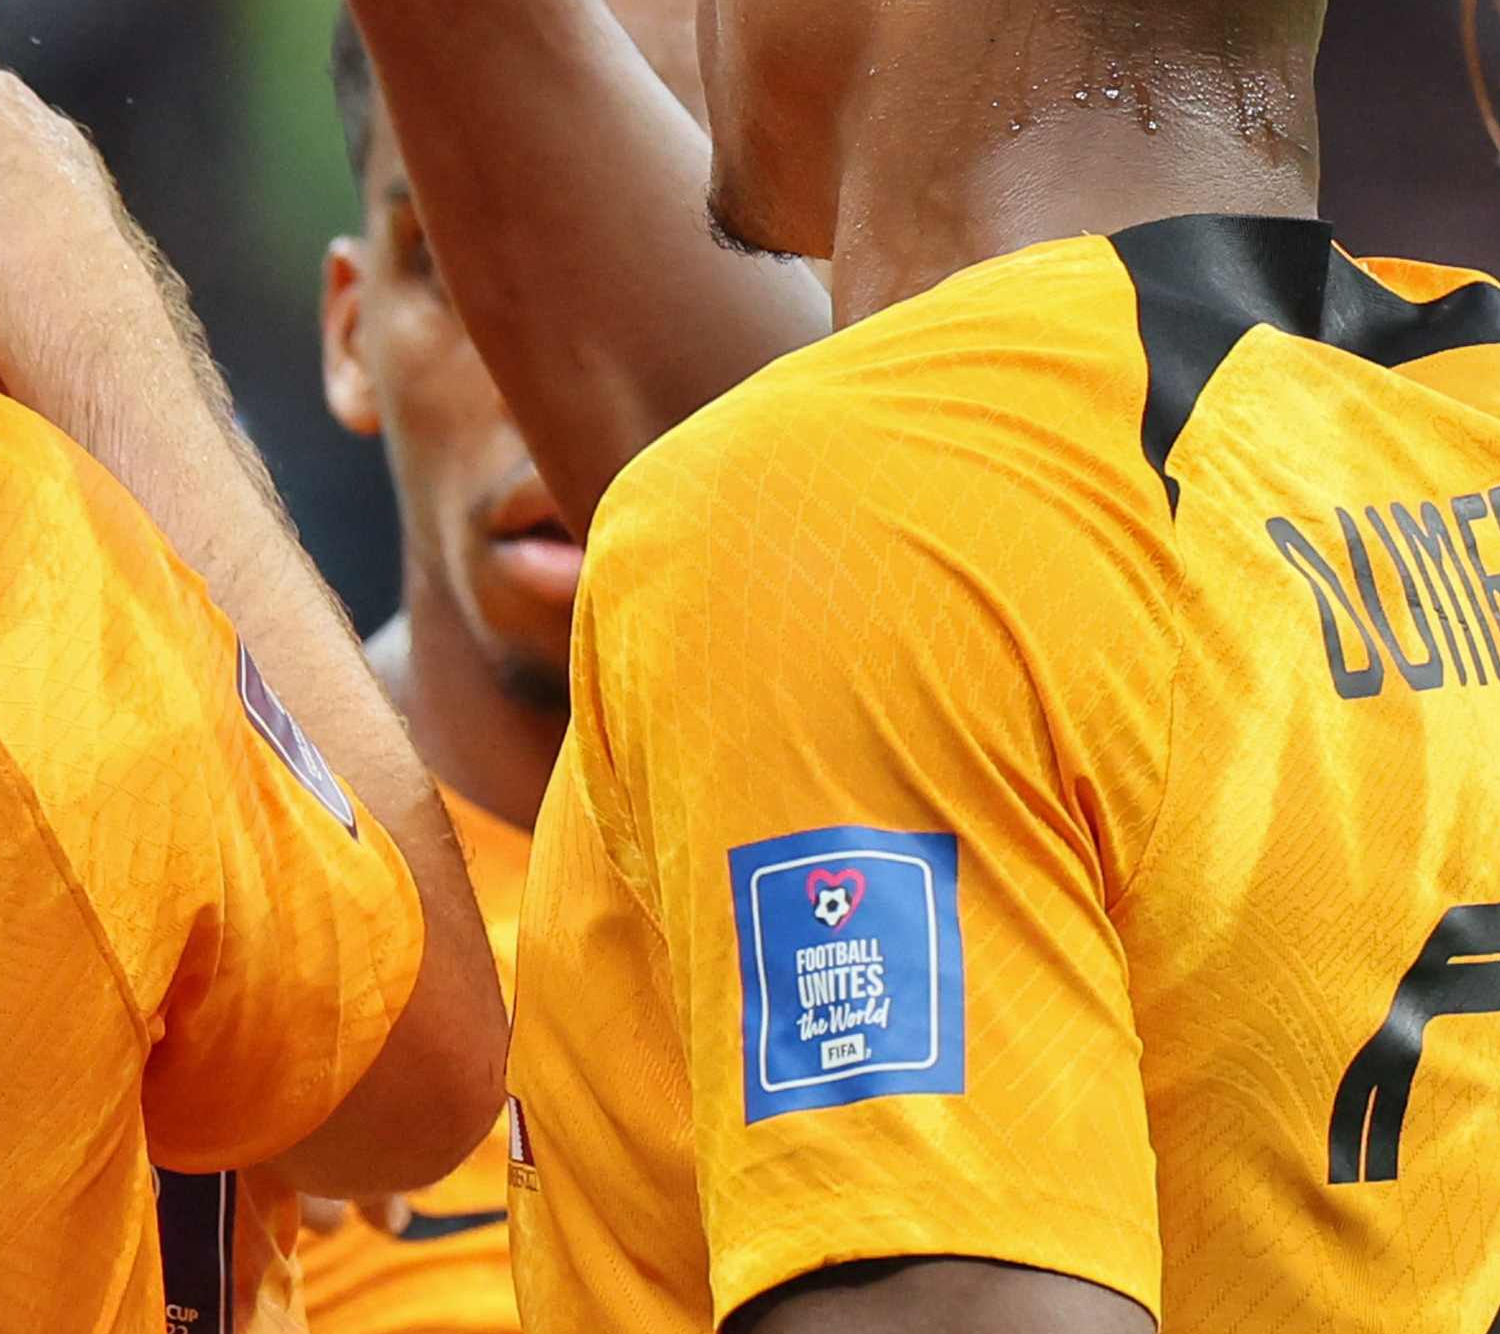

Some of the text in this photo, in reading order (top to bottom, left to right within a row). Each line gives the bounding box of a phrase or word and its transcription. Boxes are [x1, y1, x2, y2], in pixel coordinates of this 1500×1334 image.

[796, 938, 883, 974] FOOTBALL
[797, 964, 884, 1009] UNITES
[796, 997, 891, 1041] the World
[166, 1304, 199, 1323] CUP
